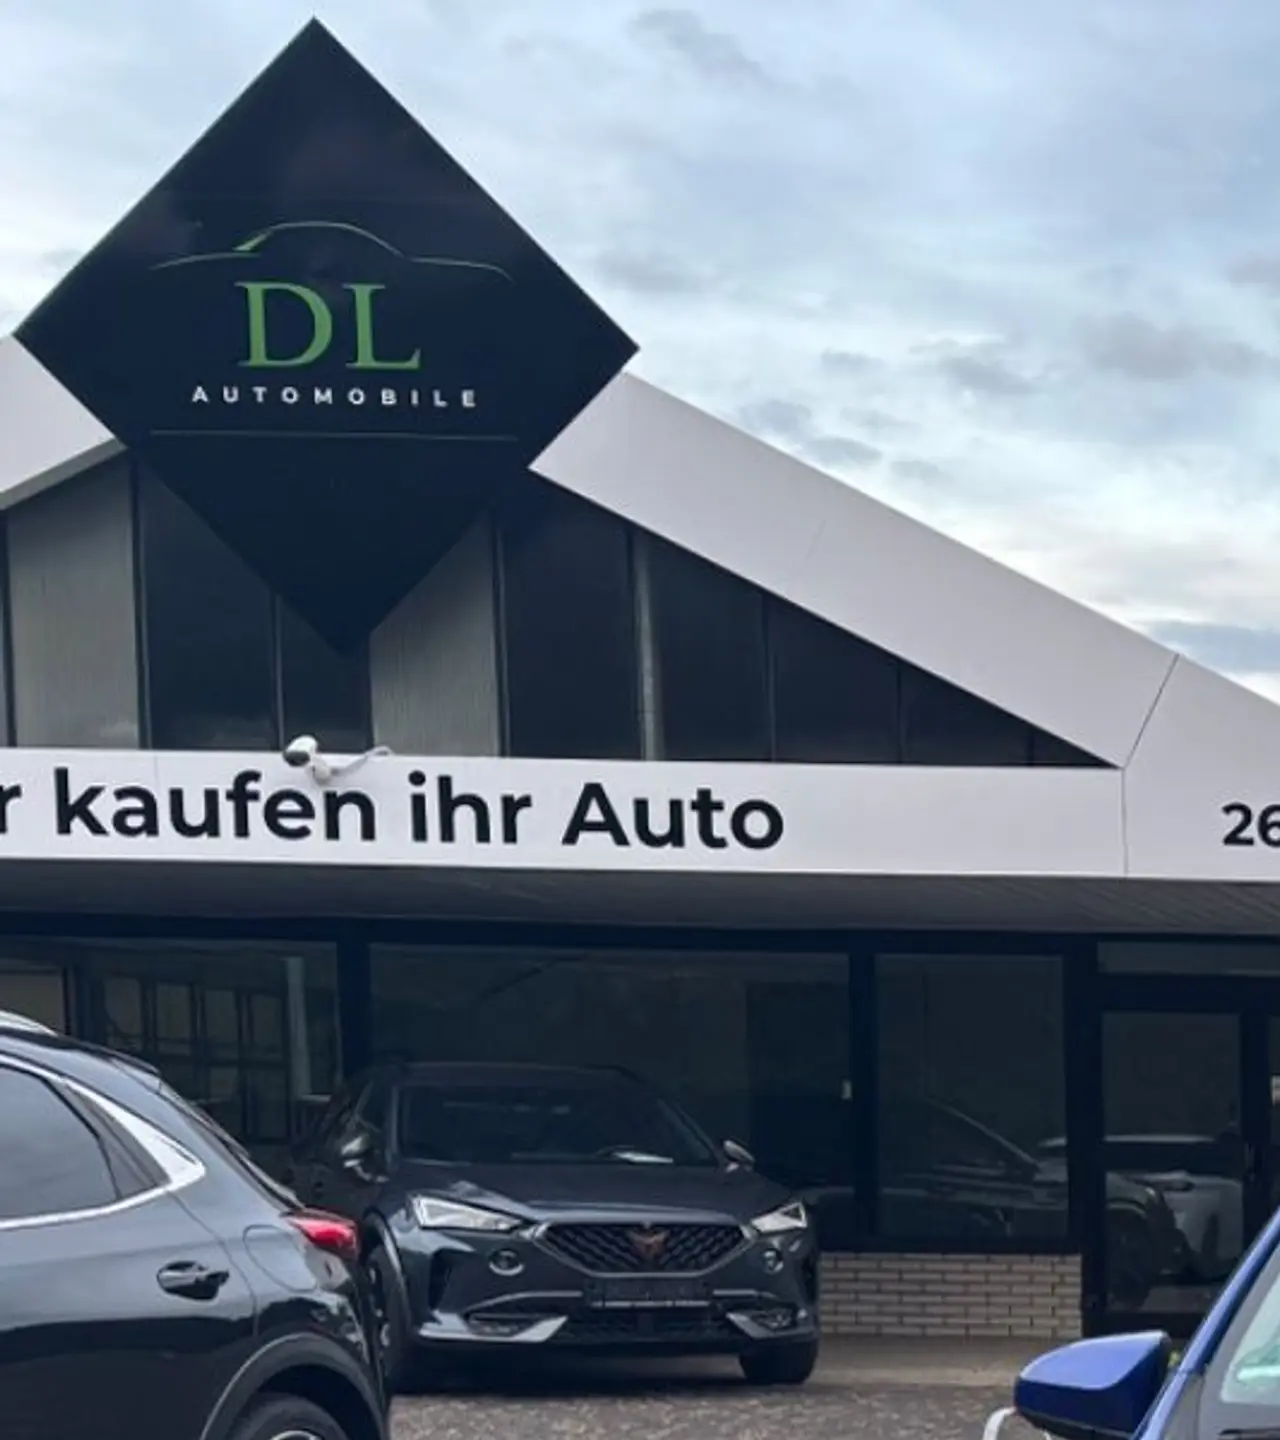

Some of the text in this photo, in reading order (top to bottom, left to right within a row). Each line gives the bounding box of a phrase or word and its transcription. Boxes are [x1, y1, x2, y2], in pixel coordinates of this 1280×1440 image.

[234, 281, 421, 369] DL
[192, 386, 476, 407] AUTOMOBILE
[54, 767, 376, 841] kaufen
[408, 770, 533, 844] ihr
[561, 782, 784, 850] Auto
